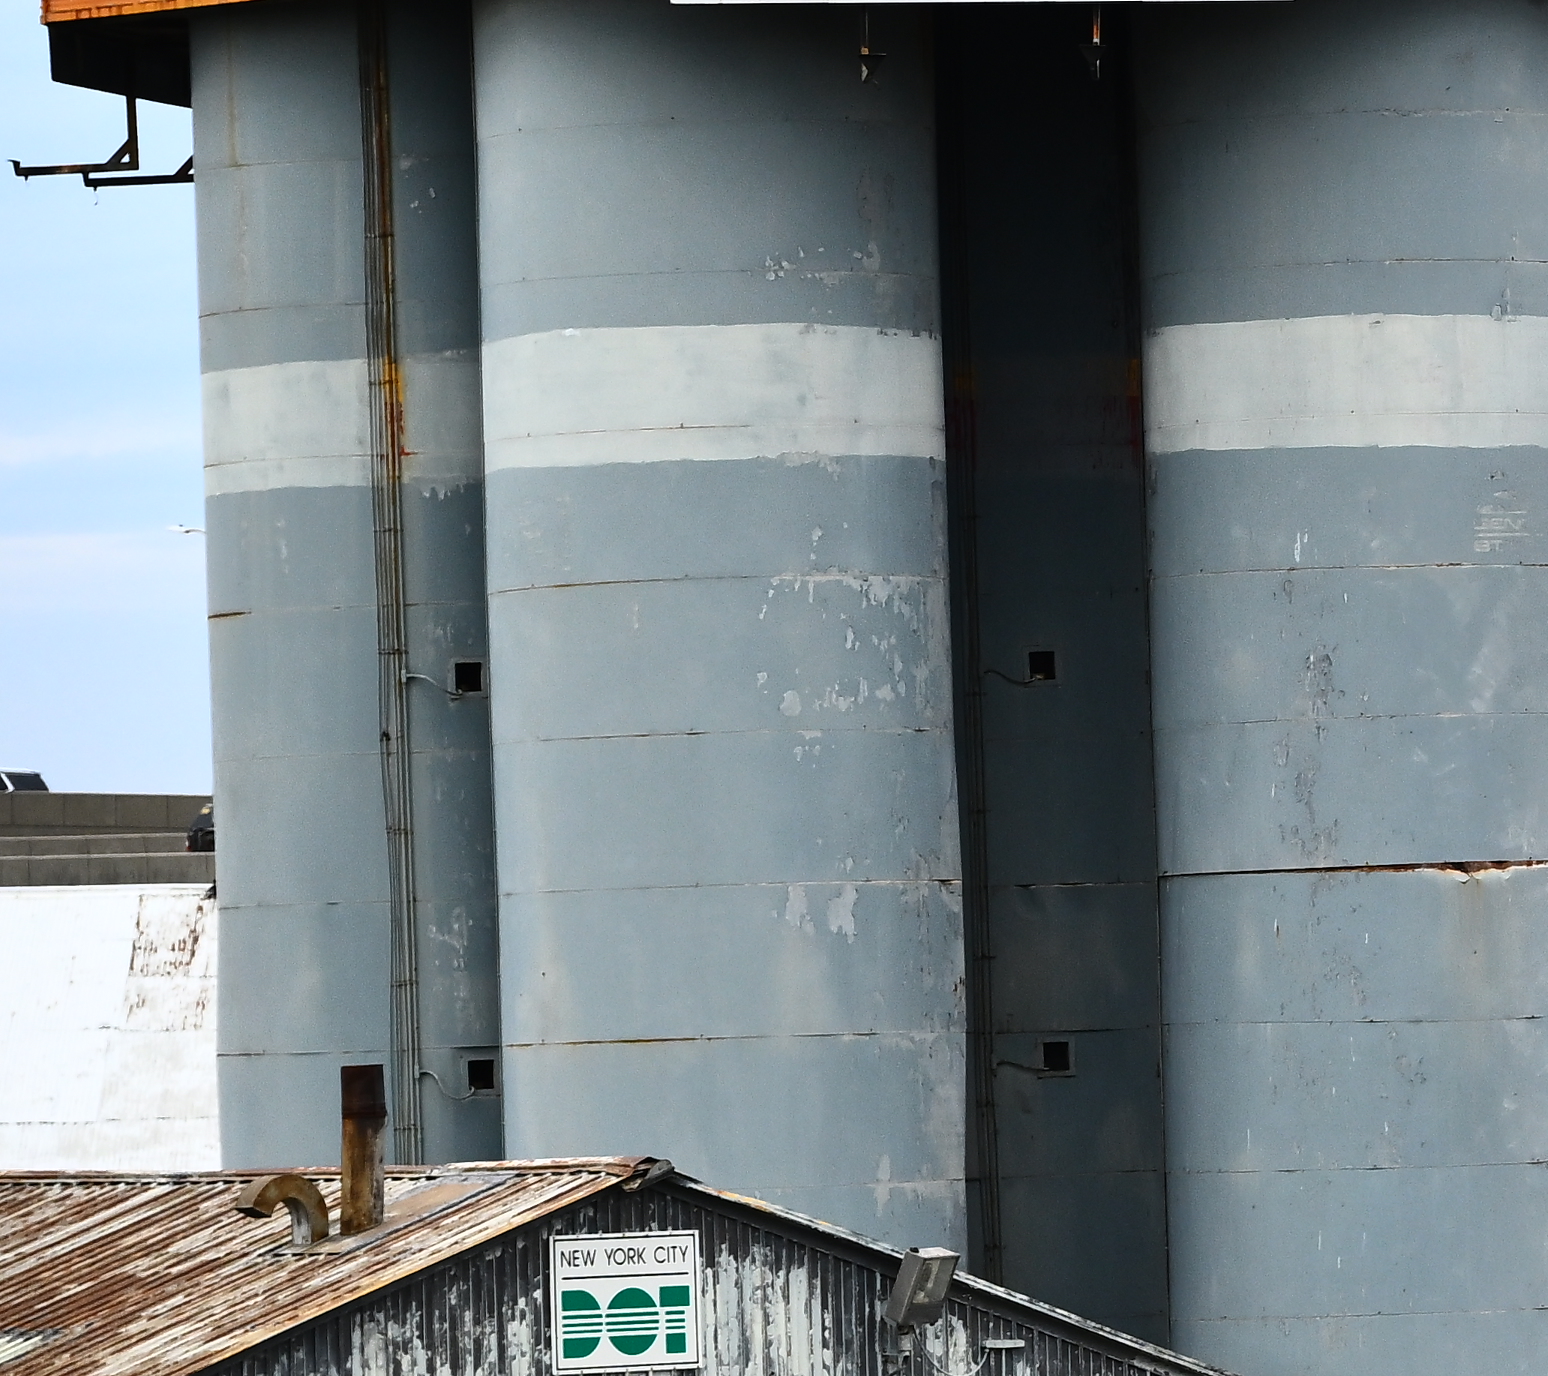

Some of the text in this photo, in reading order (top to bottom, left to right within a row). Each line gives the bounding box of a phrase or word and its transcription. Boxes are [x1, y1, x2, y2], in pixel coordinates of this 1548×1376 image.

[560, 1245, 689, 1268] NEW YORK CITY
[561, 1285, 690, 1359] DOT
